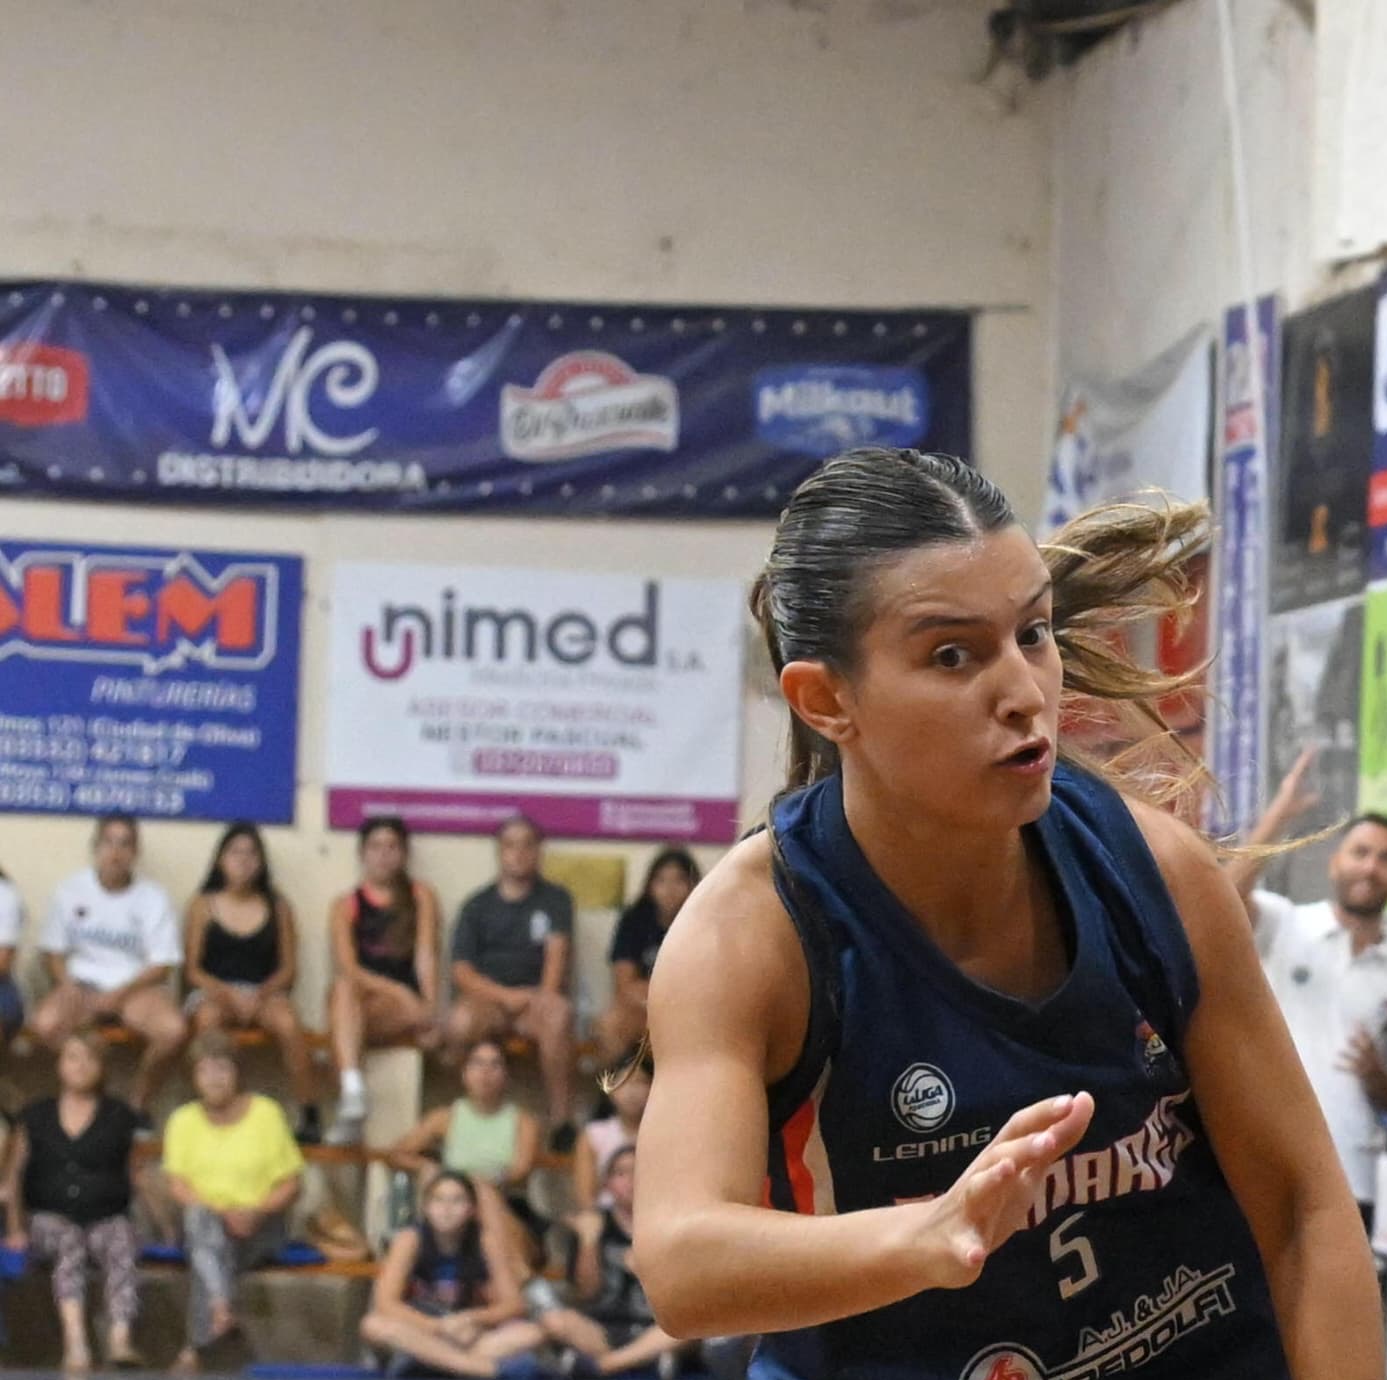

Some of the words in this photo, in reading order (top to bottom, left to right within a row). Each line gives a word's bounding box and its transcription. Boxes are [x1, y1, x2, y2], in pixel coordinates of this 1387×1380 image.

[157, 452, 426, 494] DISTRIBUIDORA
[361, 580, 660, 680] unimed
[873, 1126, 992, 1162] LENING
[1050, 1211, 1100, 1300] 5
